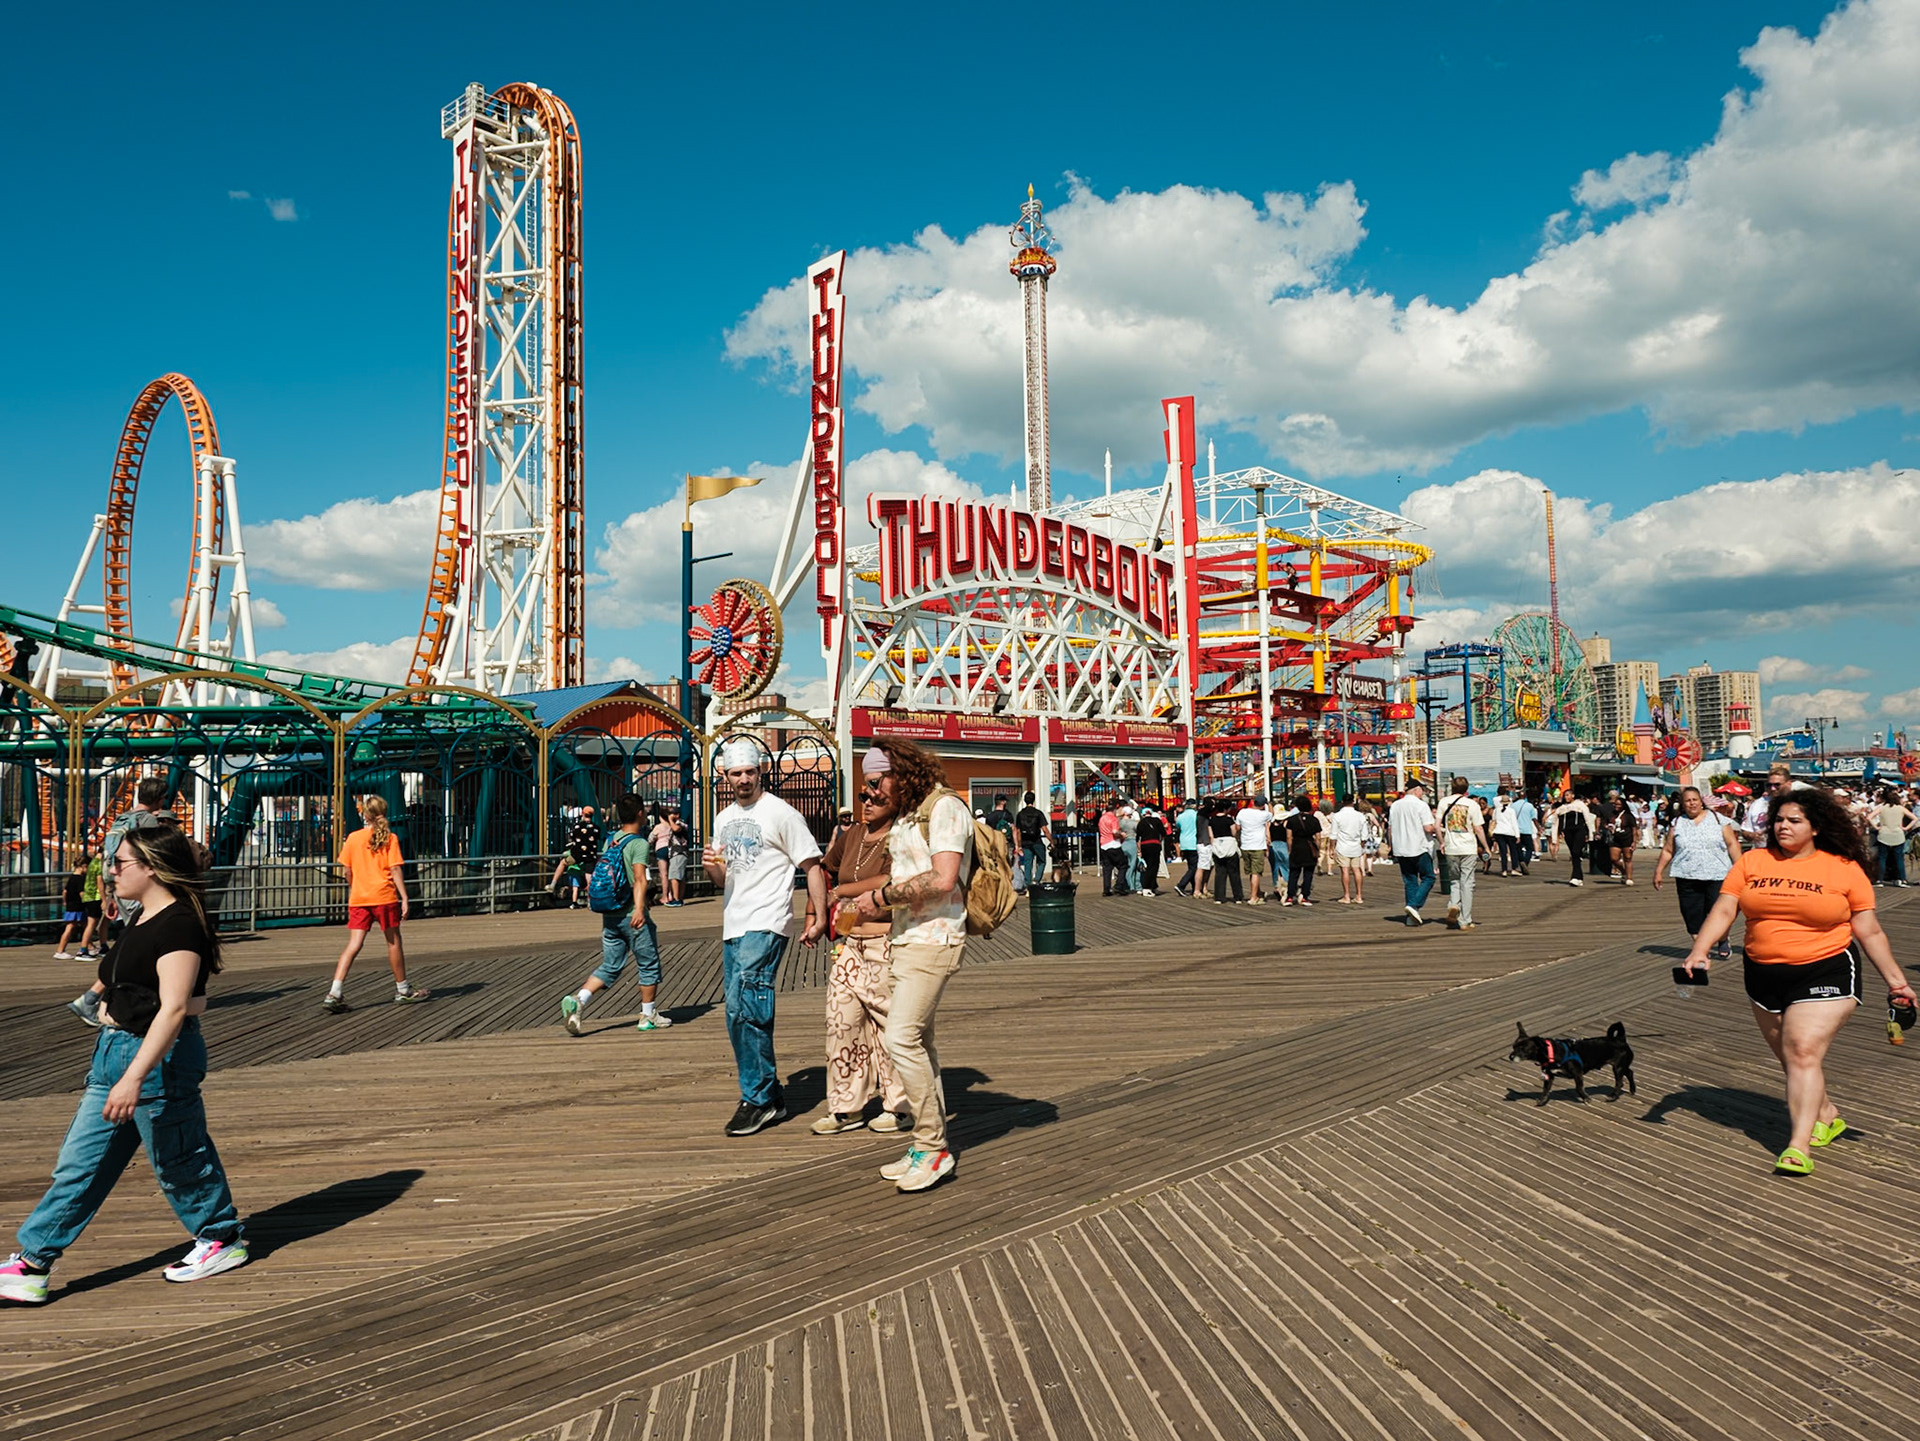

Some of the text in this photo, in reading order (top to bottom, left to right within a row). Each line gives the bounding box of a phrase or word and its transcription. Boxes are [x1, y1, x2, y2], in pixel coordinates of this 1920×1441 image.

[456, 139, 472, 585] THUNDERBOLT
[812, 267, 839, 648] THUNDERBOLT
[876, 497, 1175, 640] THUNDERBOLT
[1353, 680, 1385, 700] CHASER
[867, 710, 948, 728] THUNDERBOLT
[956, 715, 1026, 731] THUNDERBOLT
[1060, 720, 1119, 735] THUNDERBOLT
[1750, 877, 1823, 894] NEW YORK
[1809, 986, 1842, 995] HOLLISTER
